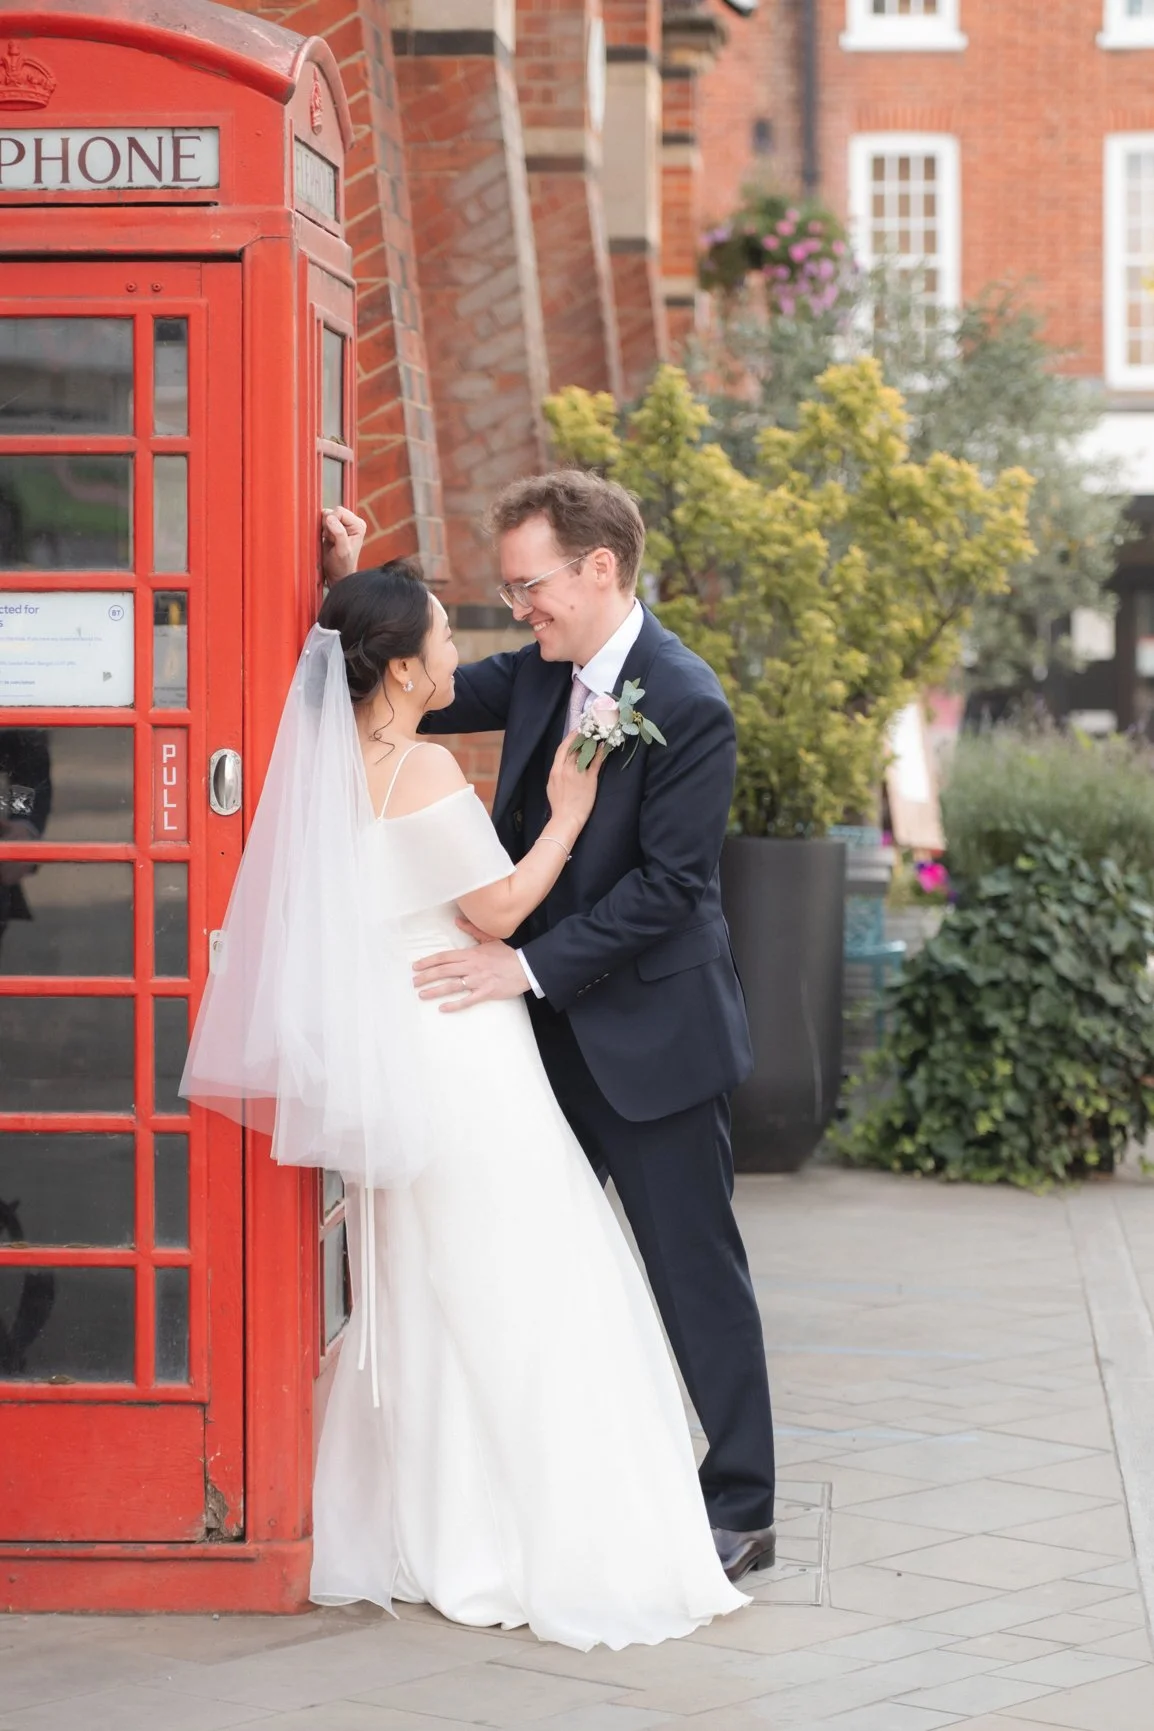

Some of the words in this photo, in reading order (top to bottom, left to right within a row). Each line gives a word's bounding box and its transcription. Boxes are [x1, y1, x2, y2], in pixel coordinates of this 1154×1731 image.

[0, 136, 202, 185] PHONE
[24, 605, 40, 614] for
[162, 744, 178, 830] PULL
